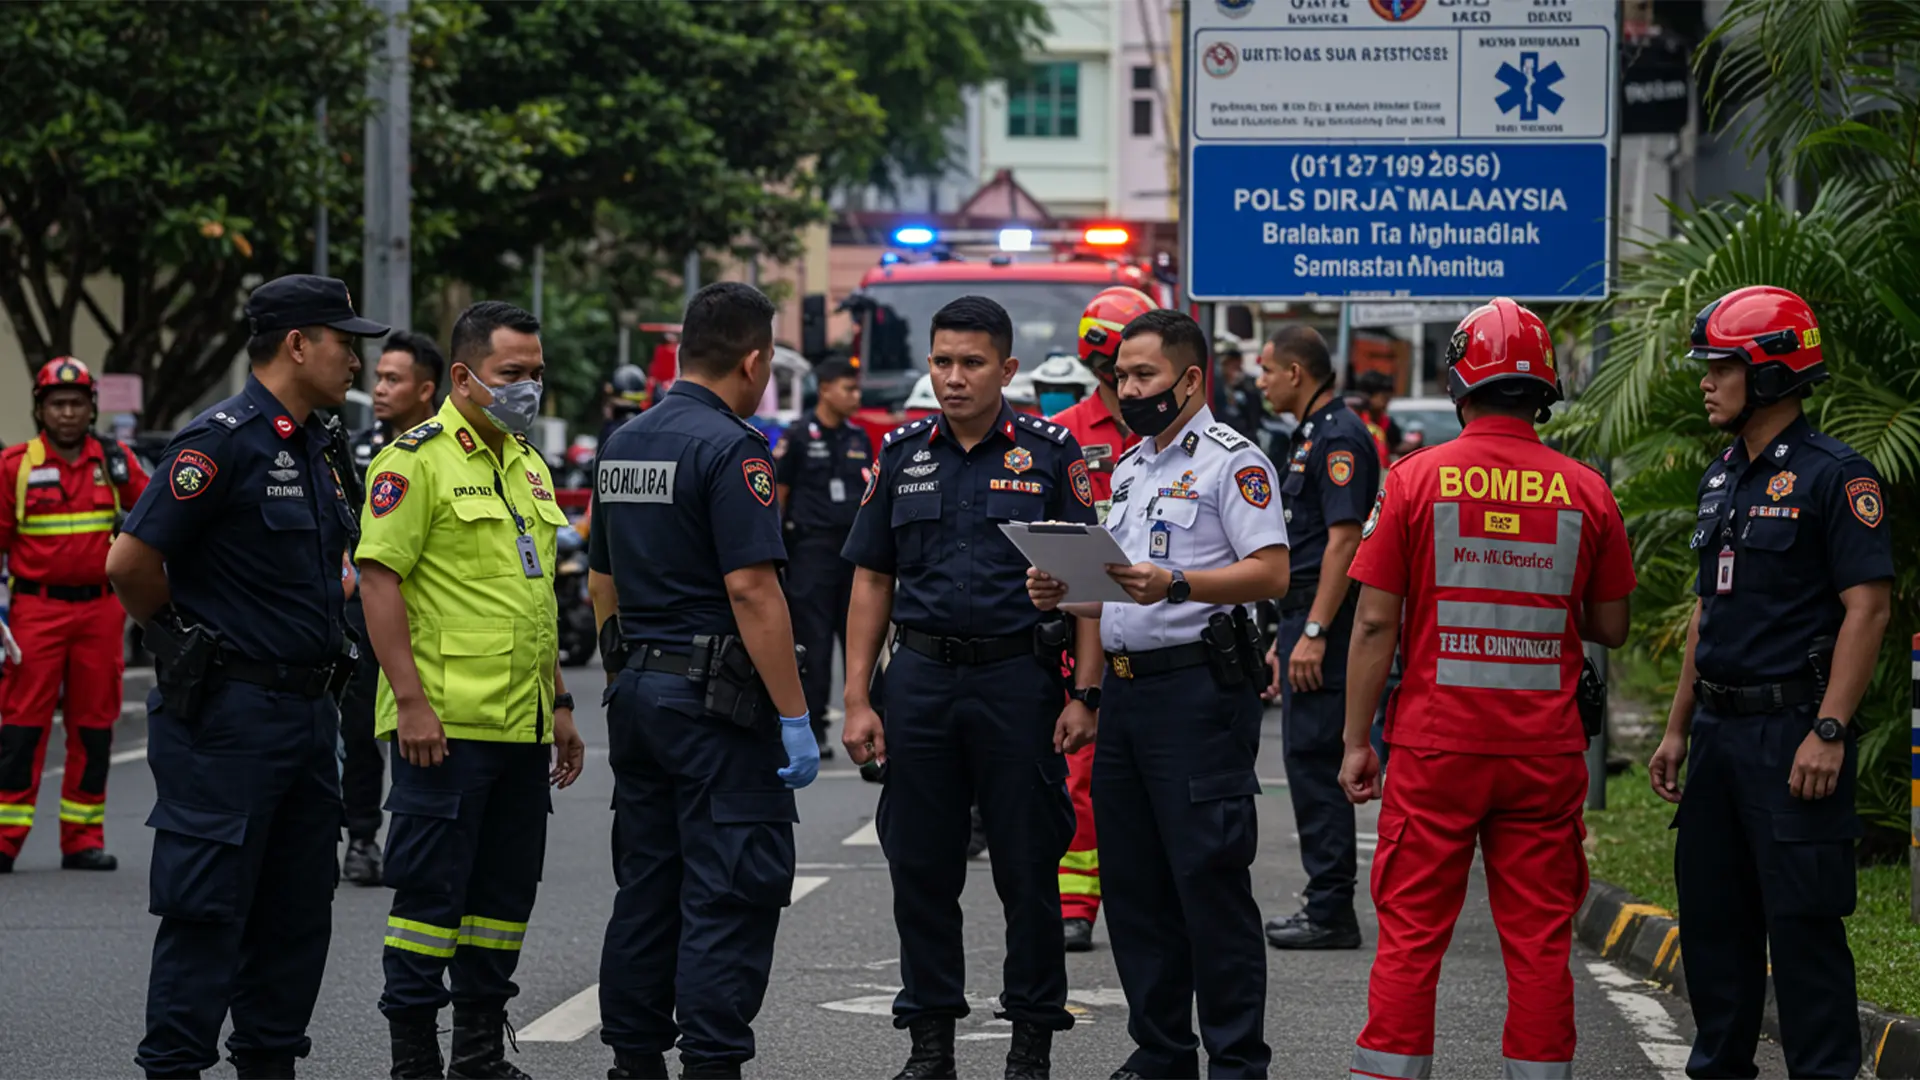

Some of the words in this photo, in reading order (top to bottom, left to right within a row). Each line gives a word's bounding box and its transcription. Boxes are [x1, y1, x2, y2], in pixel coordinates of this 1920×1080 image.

[1234, 188, 1306, 212] POLS
[1314, 188, 1399, 212] DIRJA
[1408, 188, 1568, 212] MALAAYSIA
[1438, 465, 1572, 505] BOMBA
